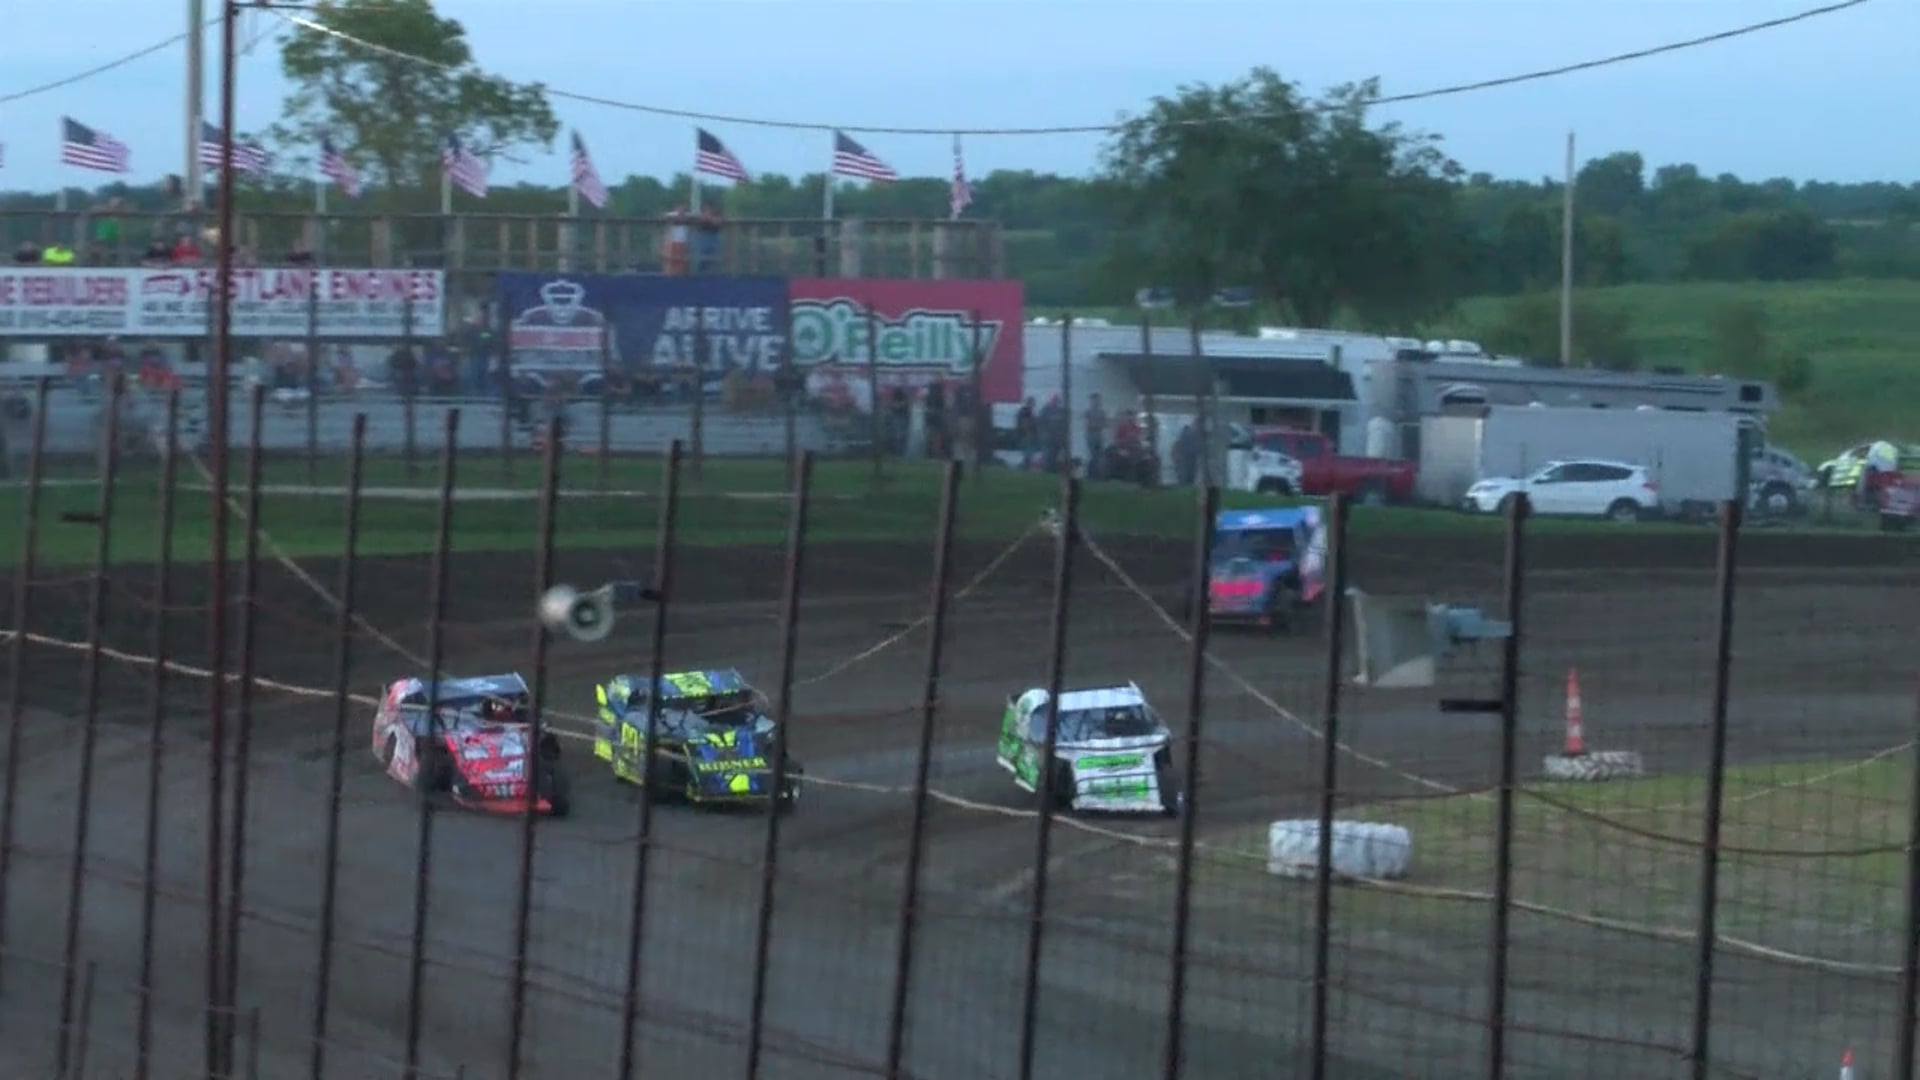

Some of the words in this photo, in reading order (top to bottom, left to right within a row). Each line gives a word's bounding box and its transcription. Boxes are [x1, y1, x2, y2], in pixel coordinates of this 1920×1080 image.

[196, 270, 321, 299] FSTLANE
[332, 270, 435, 299] ENGINES
[662, 306, 773, 332] ARRIVE
[653, 333, 785, 371] ALIVE
[790, 302, 1000, 372] O'Reilly
